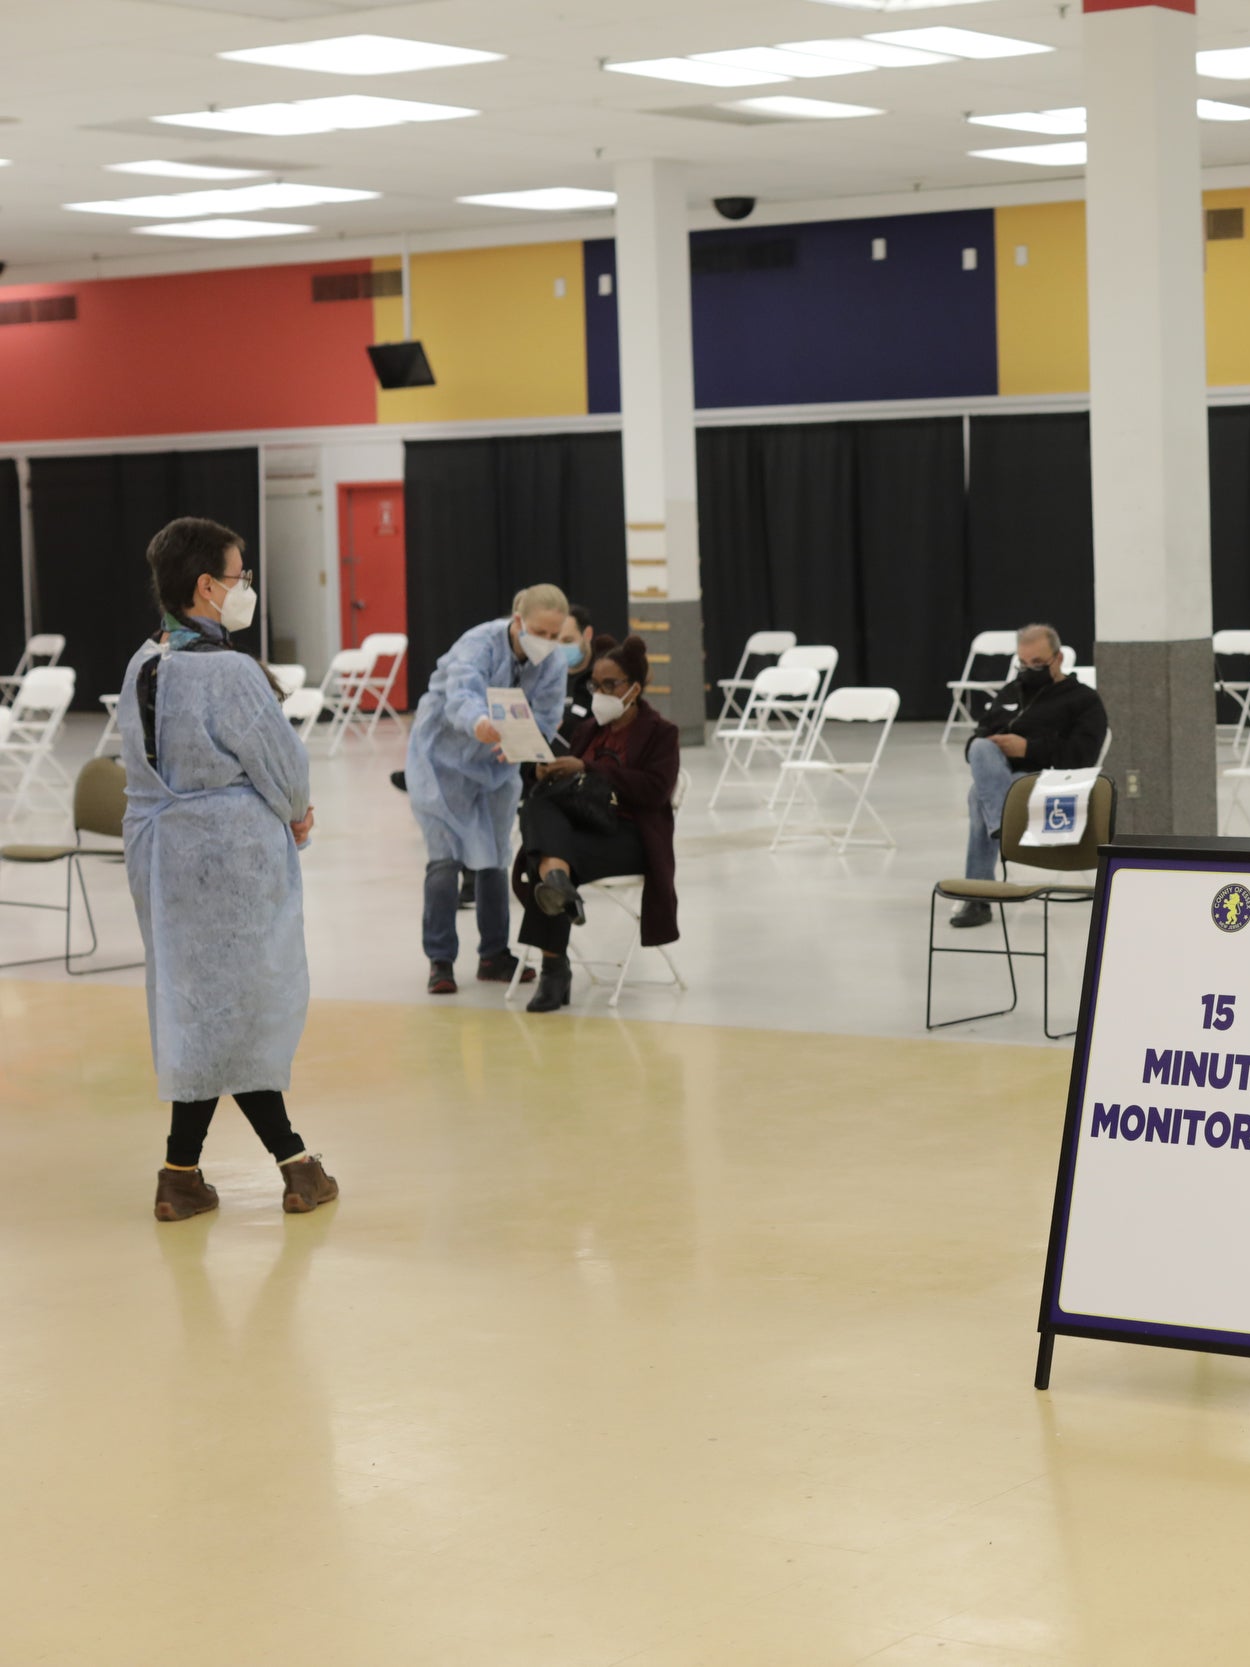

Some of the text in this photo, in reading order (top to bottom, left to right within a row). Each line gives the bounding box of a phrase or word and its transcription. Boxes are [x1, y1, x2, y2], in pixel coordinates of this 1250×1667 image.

[1214, 887, 1233, 908] COUNTY
[1234, 886, 1243, 894] OF
[1201, 993, 1237, 1031] 15
